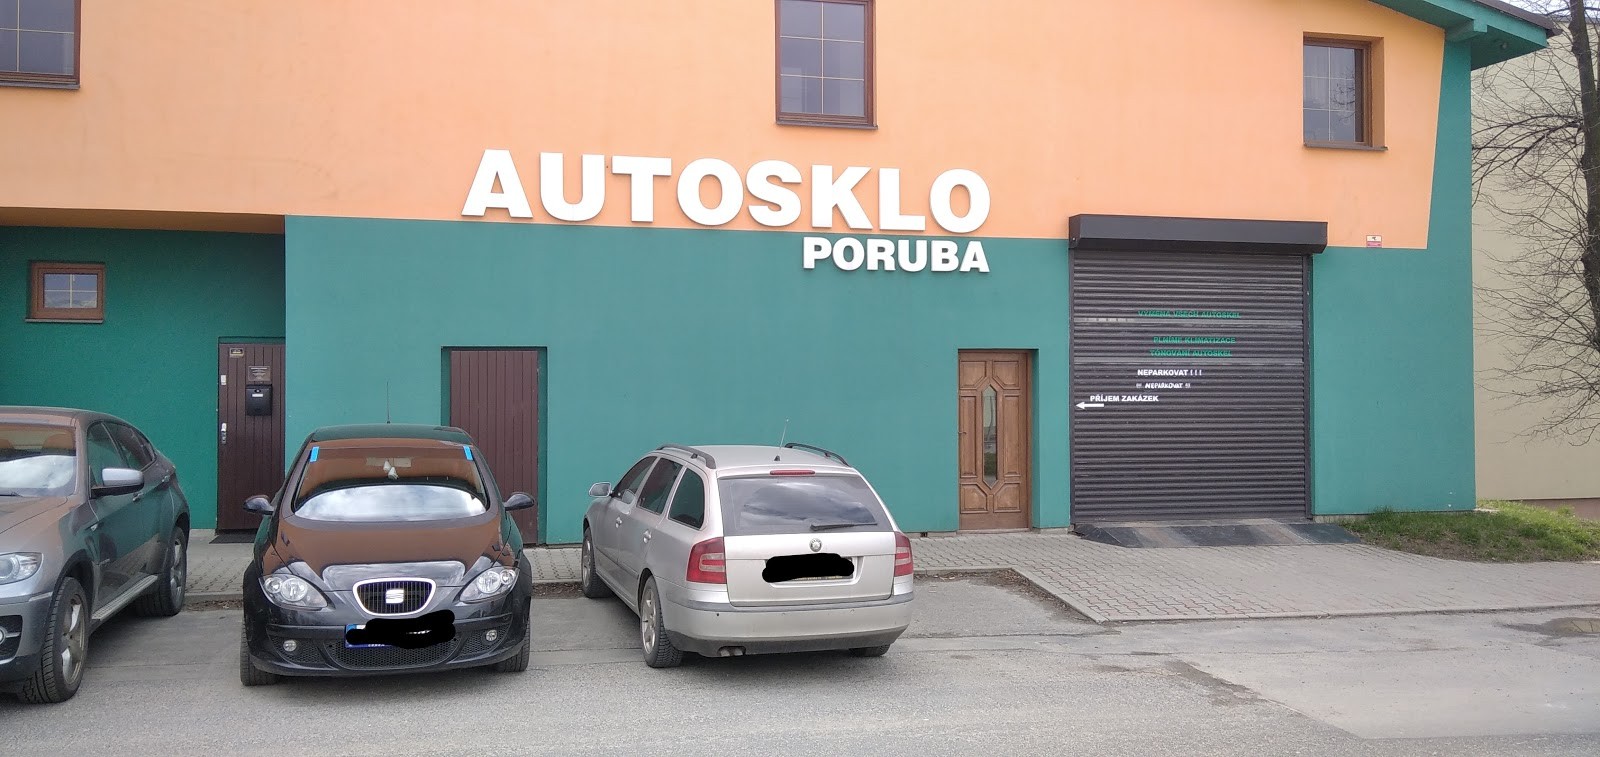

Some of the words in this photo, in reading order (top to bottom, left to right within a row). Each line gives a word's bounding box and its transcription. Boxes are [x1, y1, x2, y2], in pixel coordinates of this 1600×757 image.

[461, 149, 991, 234] AUTOSKLO
[802, 236, 991, 274] PORUBA
[1201, 311, 1241, 319] AUTOSKEL
[1184, 336, 1236, 344] KLIMATIZACE
[1090, 393, 1120, 402] PŘÍJEM
[1121, 393, 1159, 402] ZAKÁZEK
